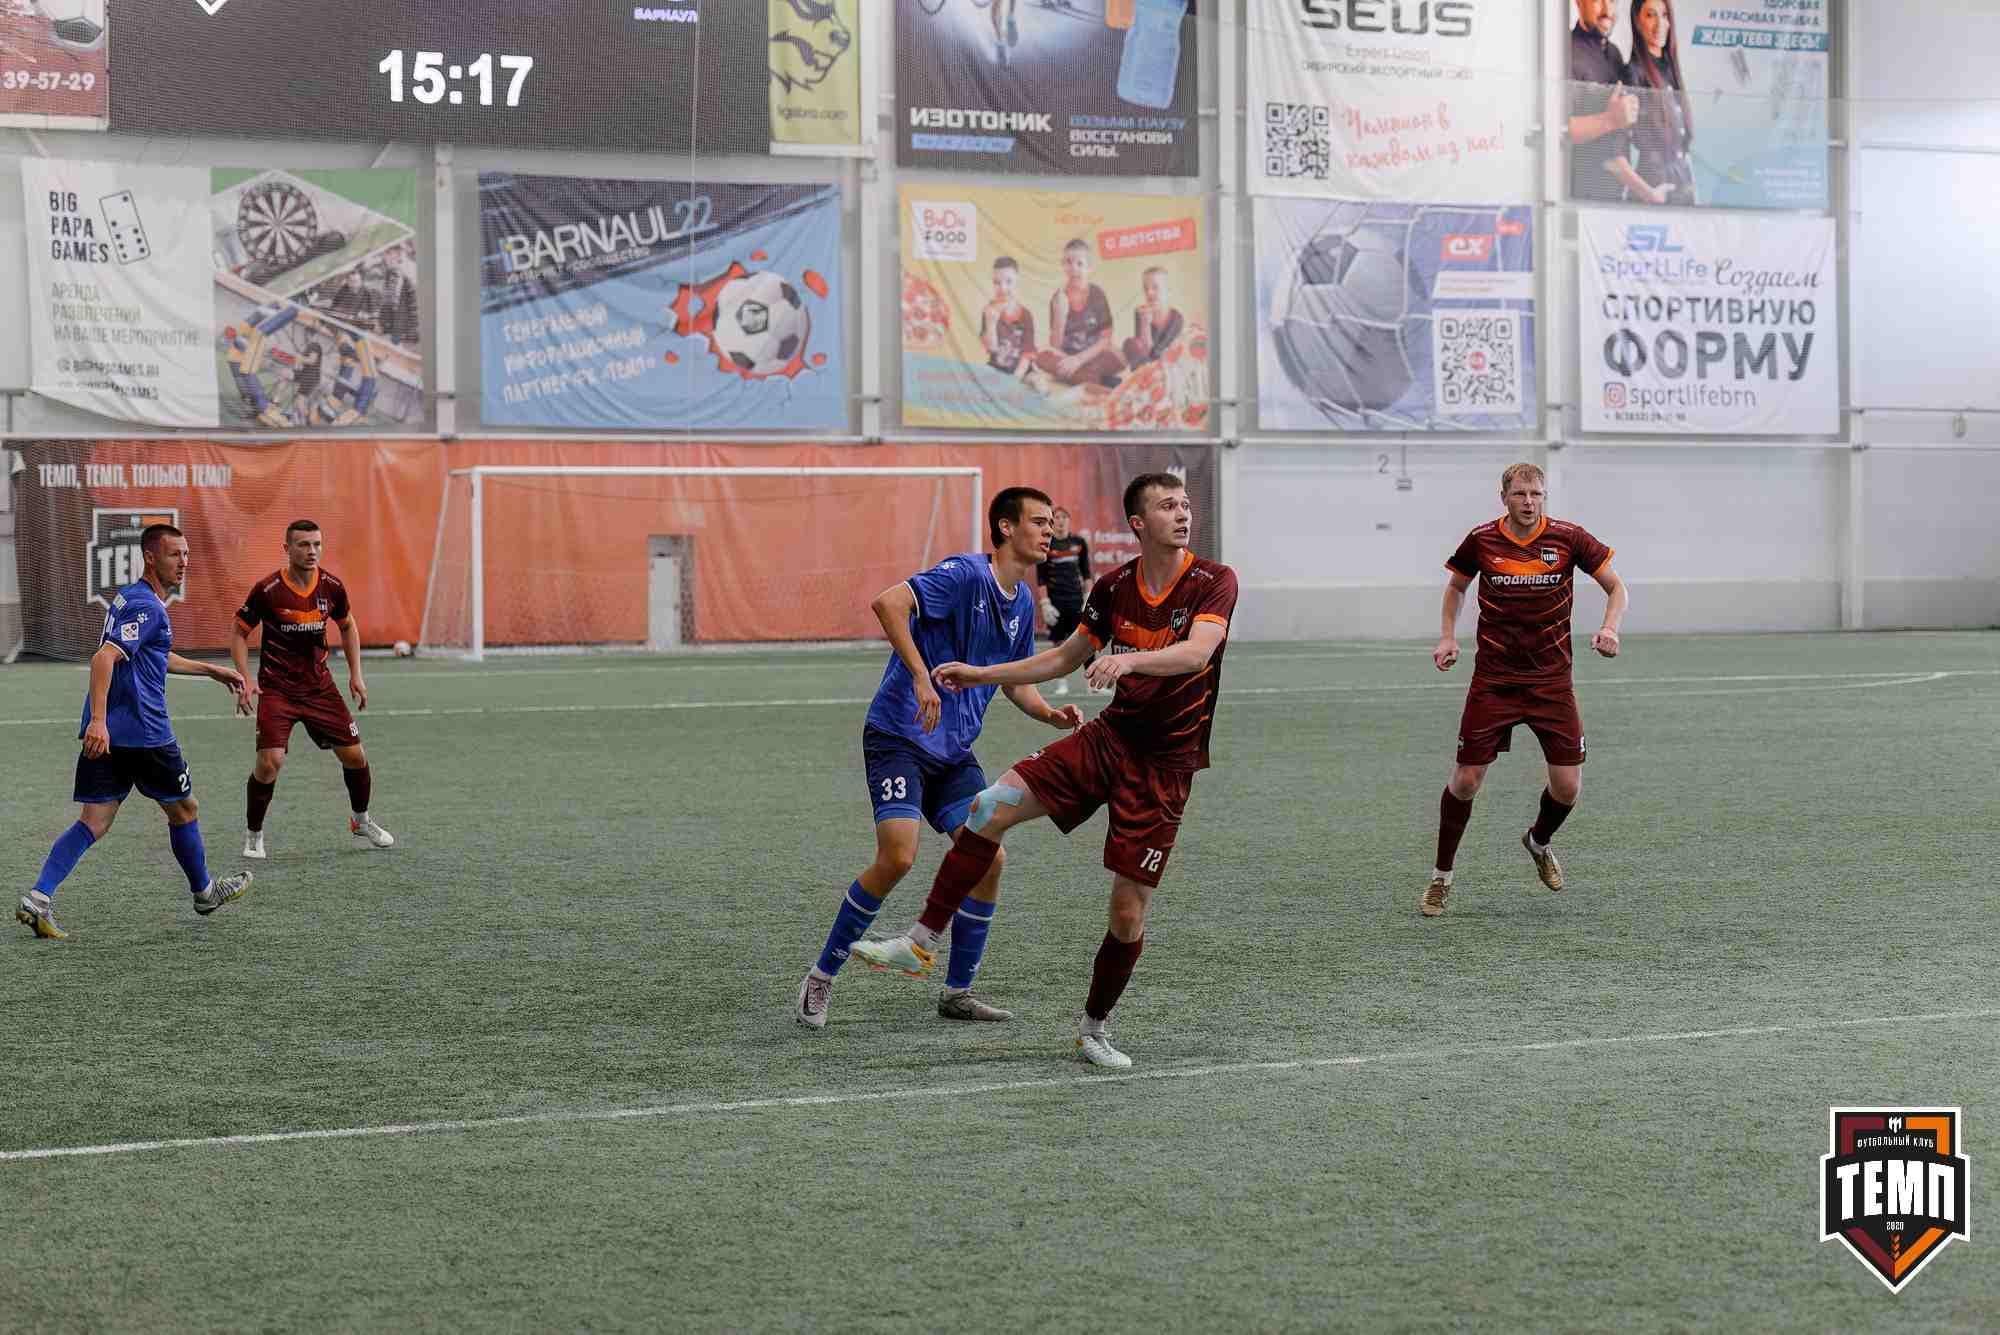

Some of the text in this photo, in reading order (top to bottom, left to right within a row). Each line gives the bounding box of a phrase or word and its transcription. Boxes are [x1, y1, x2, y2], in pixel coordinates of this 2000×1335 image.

[1301, 0, 1475, 37] SEUS
[3, 70, 96, 91] 39-57-29
[379, 49, 533, 107] 15:17
[909, 106, 1052, 132] ИЗОТОНИК
[1069, 128, 1173, 145] ВОССТАНОВИ
[50, 191, 78, 212] BIG
[51, 216, 94, 238] PAPA
[51, 240, 109, 263] GAMES
[1714, 258, 1821, 295] Создаем
[1602, 293, 1816, 325] СПОРТИВНУЮ
[1603, 328, 1815, 381] ФОРМУ
[1631, 384, 1757, 408] sportlifebrn
[39, 463, 81, 489] ТЕМП,
[85, 463, 128, 489] ТЕМП,
[132, 463, 187, 488] ТОЛЬКО
[1378, 455, 1389, 475] 2
[97, 543, 145, 588] ТЕМ
[1491, 574, 1562, 585] ПРОДИНВЕСТ
[881, 776, 907, 801] 33
[1139, 847, 1162, 872] 72
